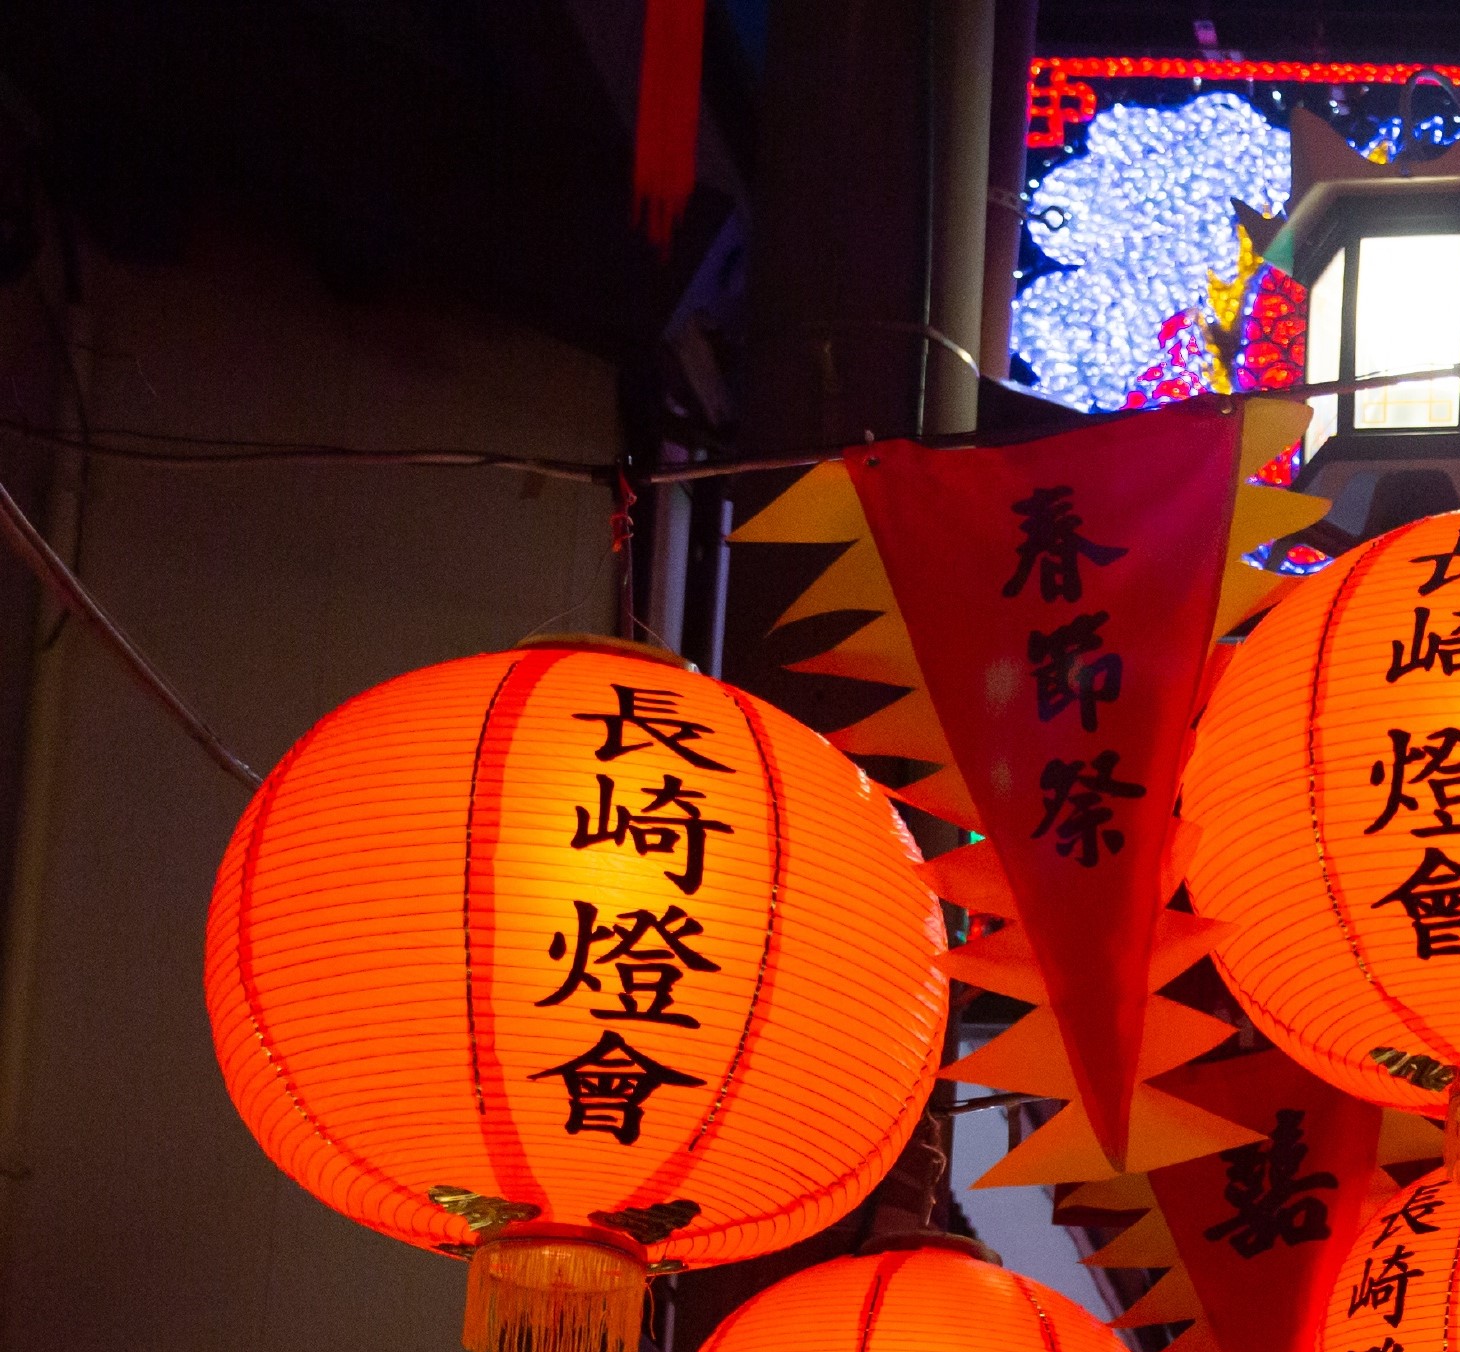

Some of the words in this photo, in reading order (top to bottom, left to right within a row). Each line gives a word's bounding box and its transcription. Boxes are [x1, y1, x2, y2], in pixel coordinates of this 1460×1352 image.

[1002, 485, 1147, 868] 春節祭
[528, 682, 736, 1145] 長崎燈會
